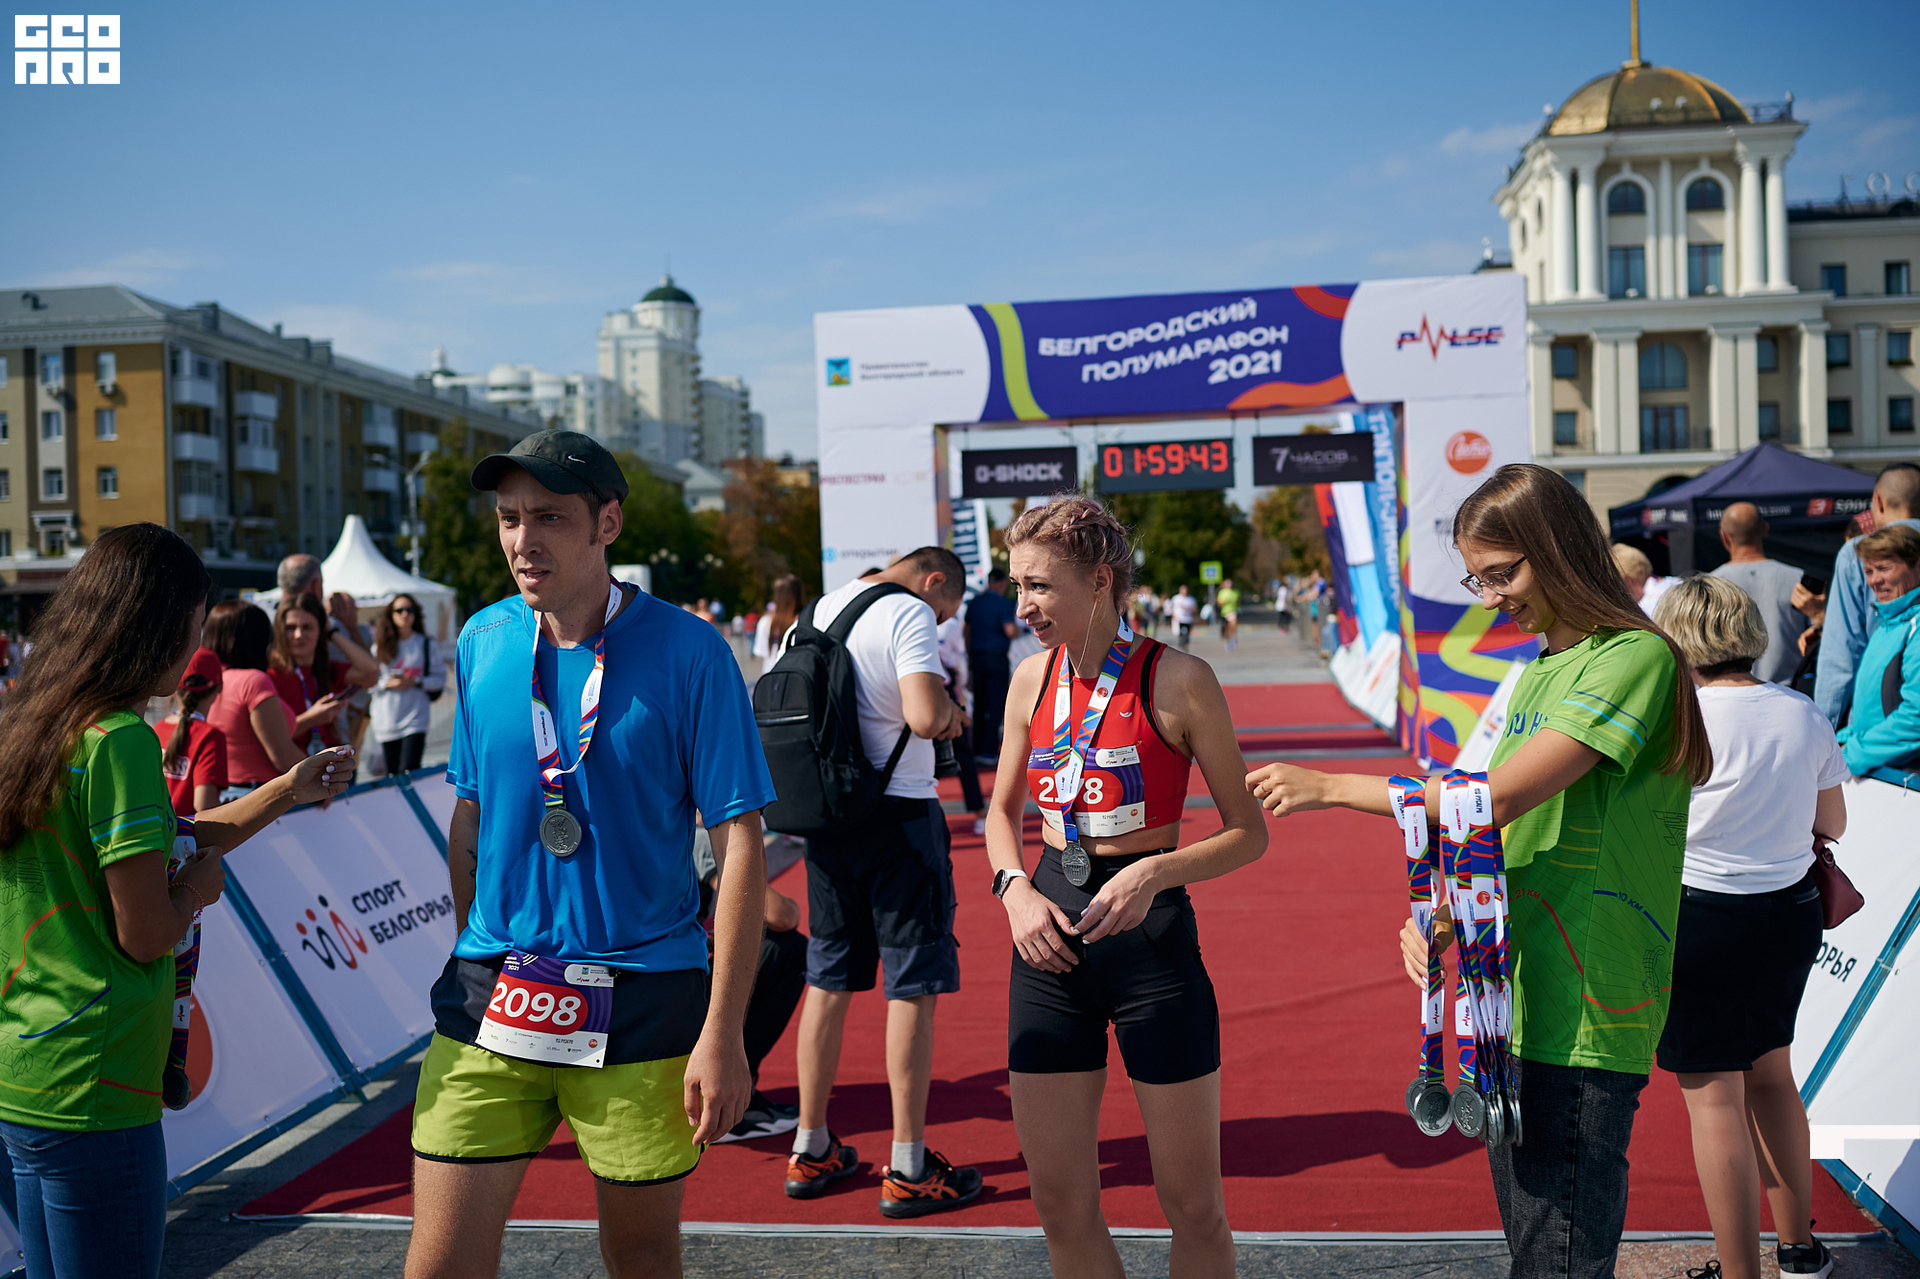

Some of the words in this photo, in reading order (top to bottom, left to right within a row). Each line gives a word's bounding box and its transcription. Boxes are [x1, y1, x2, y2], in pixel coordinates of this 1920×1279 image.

[1038, 298, 1257, 357] БЕЛГОРОДСКИЙ
[1081, 325, 1289, 384] ПОЛУМАРАФОН
[1207, 349, 1282, 385] 2021
[1103, 441, 1229, 478] 01:59:43
[352, 880, 406, 914] СПОРТ
[369, 895, 455, 944] БЕЛОГОРЬЯ
[489, 982, 581, 1026] 2098
